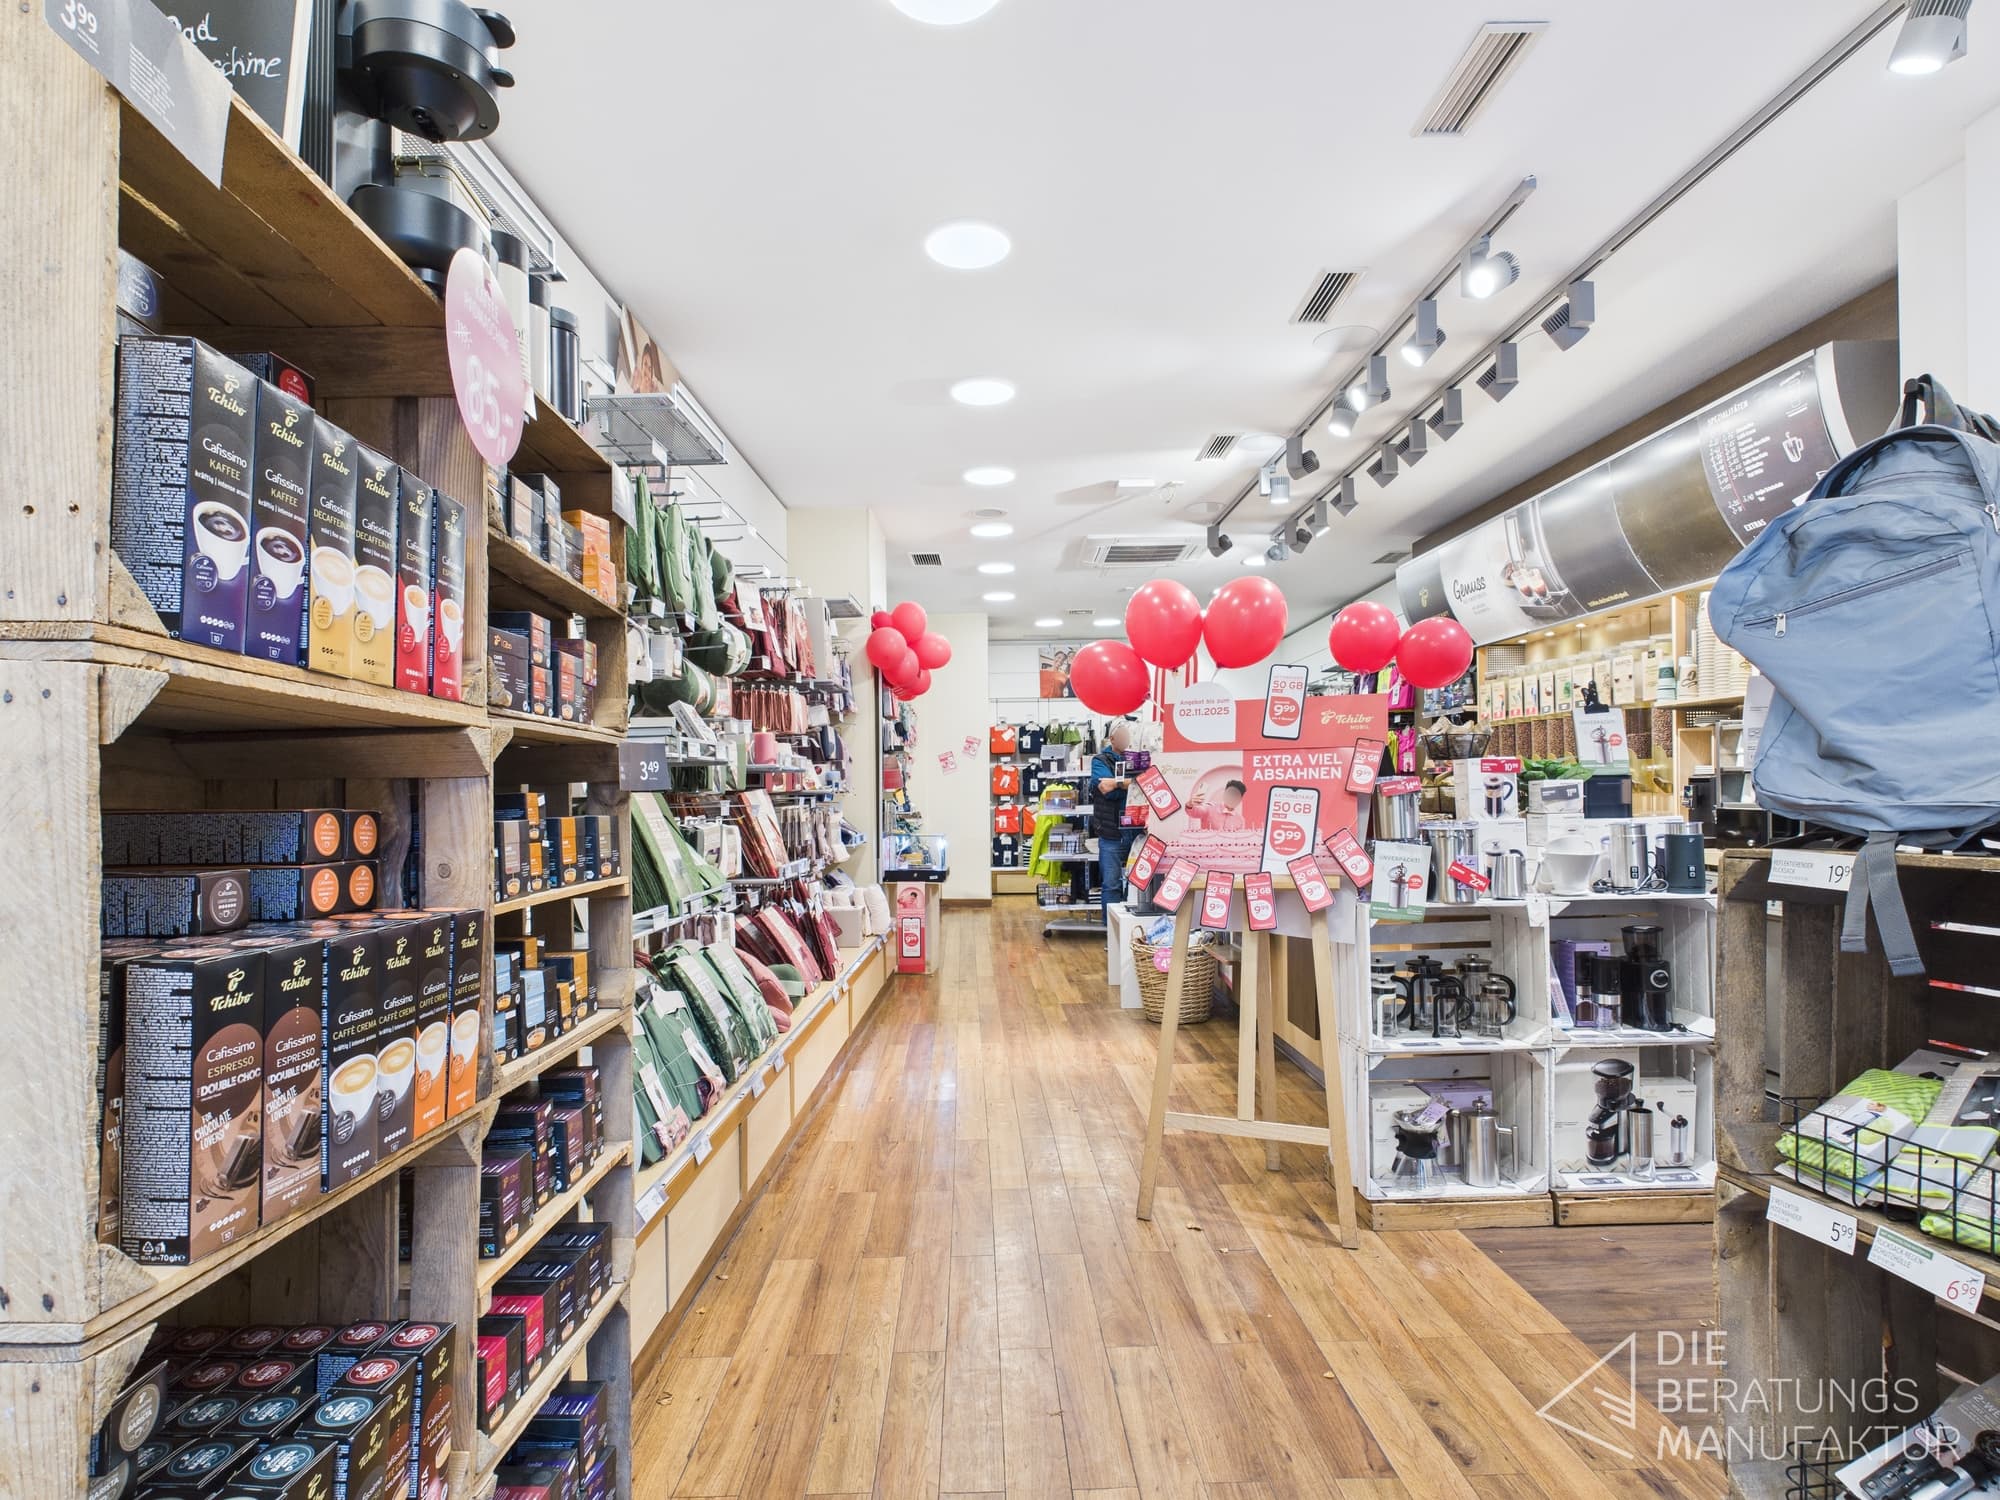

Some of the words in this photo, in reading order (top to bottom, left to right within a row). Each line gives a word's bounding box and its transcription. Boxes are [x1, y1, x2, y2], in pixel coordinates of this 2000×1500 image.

[208, 387, 247, 417] Tchibo
[270, 422, 304, 448] Tchibo
[202, 437, 248, 468] Cafissimo
[209, 458, 241, 481] KAFFEE
[322, 452, 350, 476] Tchibo
[264, 469, 304, 496] Cafissimo
[364, 478, 391, 498] Tchibo
[270, 487, 299, 507] KAFFEE
[320, 496, 352, 520] Cafissimo
[362, 518, 392, 538] Cafissimo
[1452, 576, 1487, 602] Genuss
[1272, 680, 1288, 689] 50
[1289, 681, 1304, 690] GB
[1179, 707, 1230, 717] 02.11.2025
[1273, 705, 1296, 717] 999
[1335, 712, 1374, 724] Tchibo
[1252, 755, 1303, 768] EXTRA
[1308, 753, 1343, 766] VIEL
[639, 761, 660, 781] 349
[1252, 766, 1342, 781] ABSAHNEN
[1273, 801, 1291, 812] 50
[1293, 803, 1312, 814] GB
[1273, 829, 1302, 845] 999
[1828, 865, 1851, 883] 199
[425, 945, 445, 958] Tchibo
[461, 937, 479, 949] Tchibo
[386, 955, 412, 970] Tchibo
[281, 976, 312, 992] Tchibo
[340, 966, 371, 982] Tchibo
[423, 981, 446, 996] Cafissimo
[210, 991, 254, 1012] Tchibo
[383, 994, 413, 1010] Cafissimo
[338, 1008, 374, 1025] Cafissimo
[332, 1025, 355, 1041] CAFFÈ
[356, 1019, 377, 1033] CREMA
[206, 1041, 256, 1063] Cafissimo
[275, 1033, 316, 1053] Cafissimo
[207, 1055, 254, 1078] ESPRESSO
[276, 1047, 316, 1068] ESPRESSO
[269, 1065, 300, 1085] DOUBLE
[300, 1058, 320, 1072] CHOC
[200, 1076, 237, 1097] DOUBLE
[237, 1067, 261, 1083] CHOC
[265, 1085, 298, 1114] CHOCOLATE
[194, 1108, 232, 1142] CHOCOLATE
[1830, 1221, 1854, 1242] 599
[1946, 1280, 1977, 1300] 699
